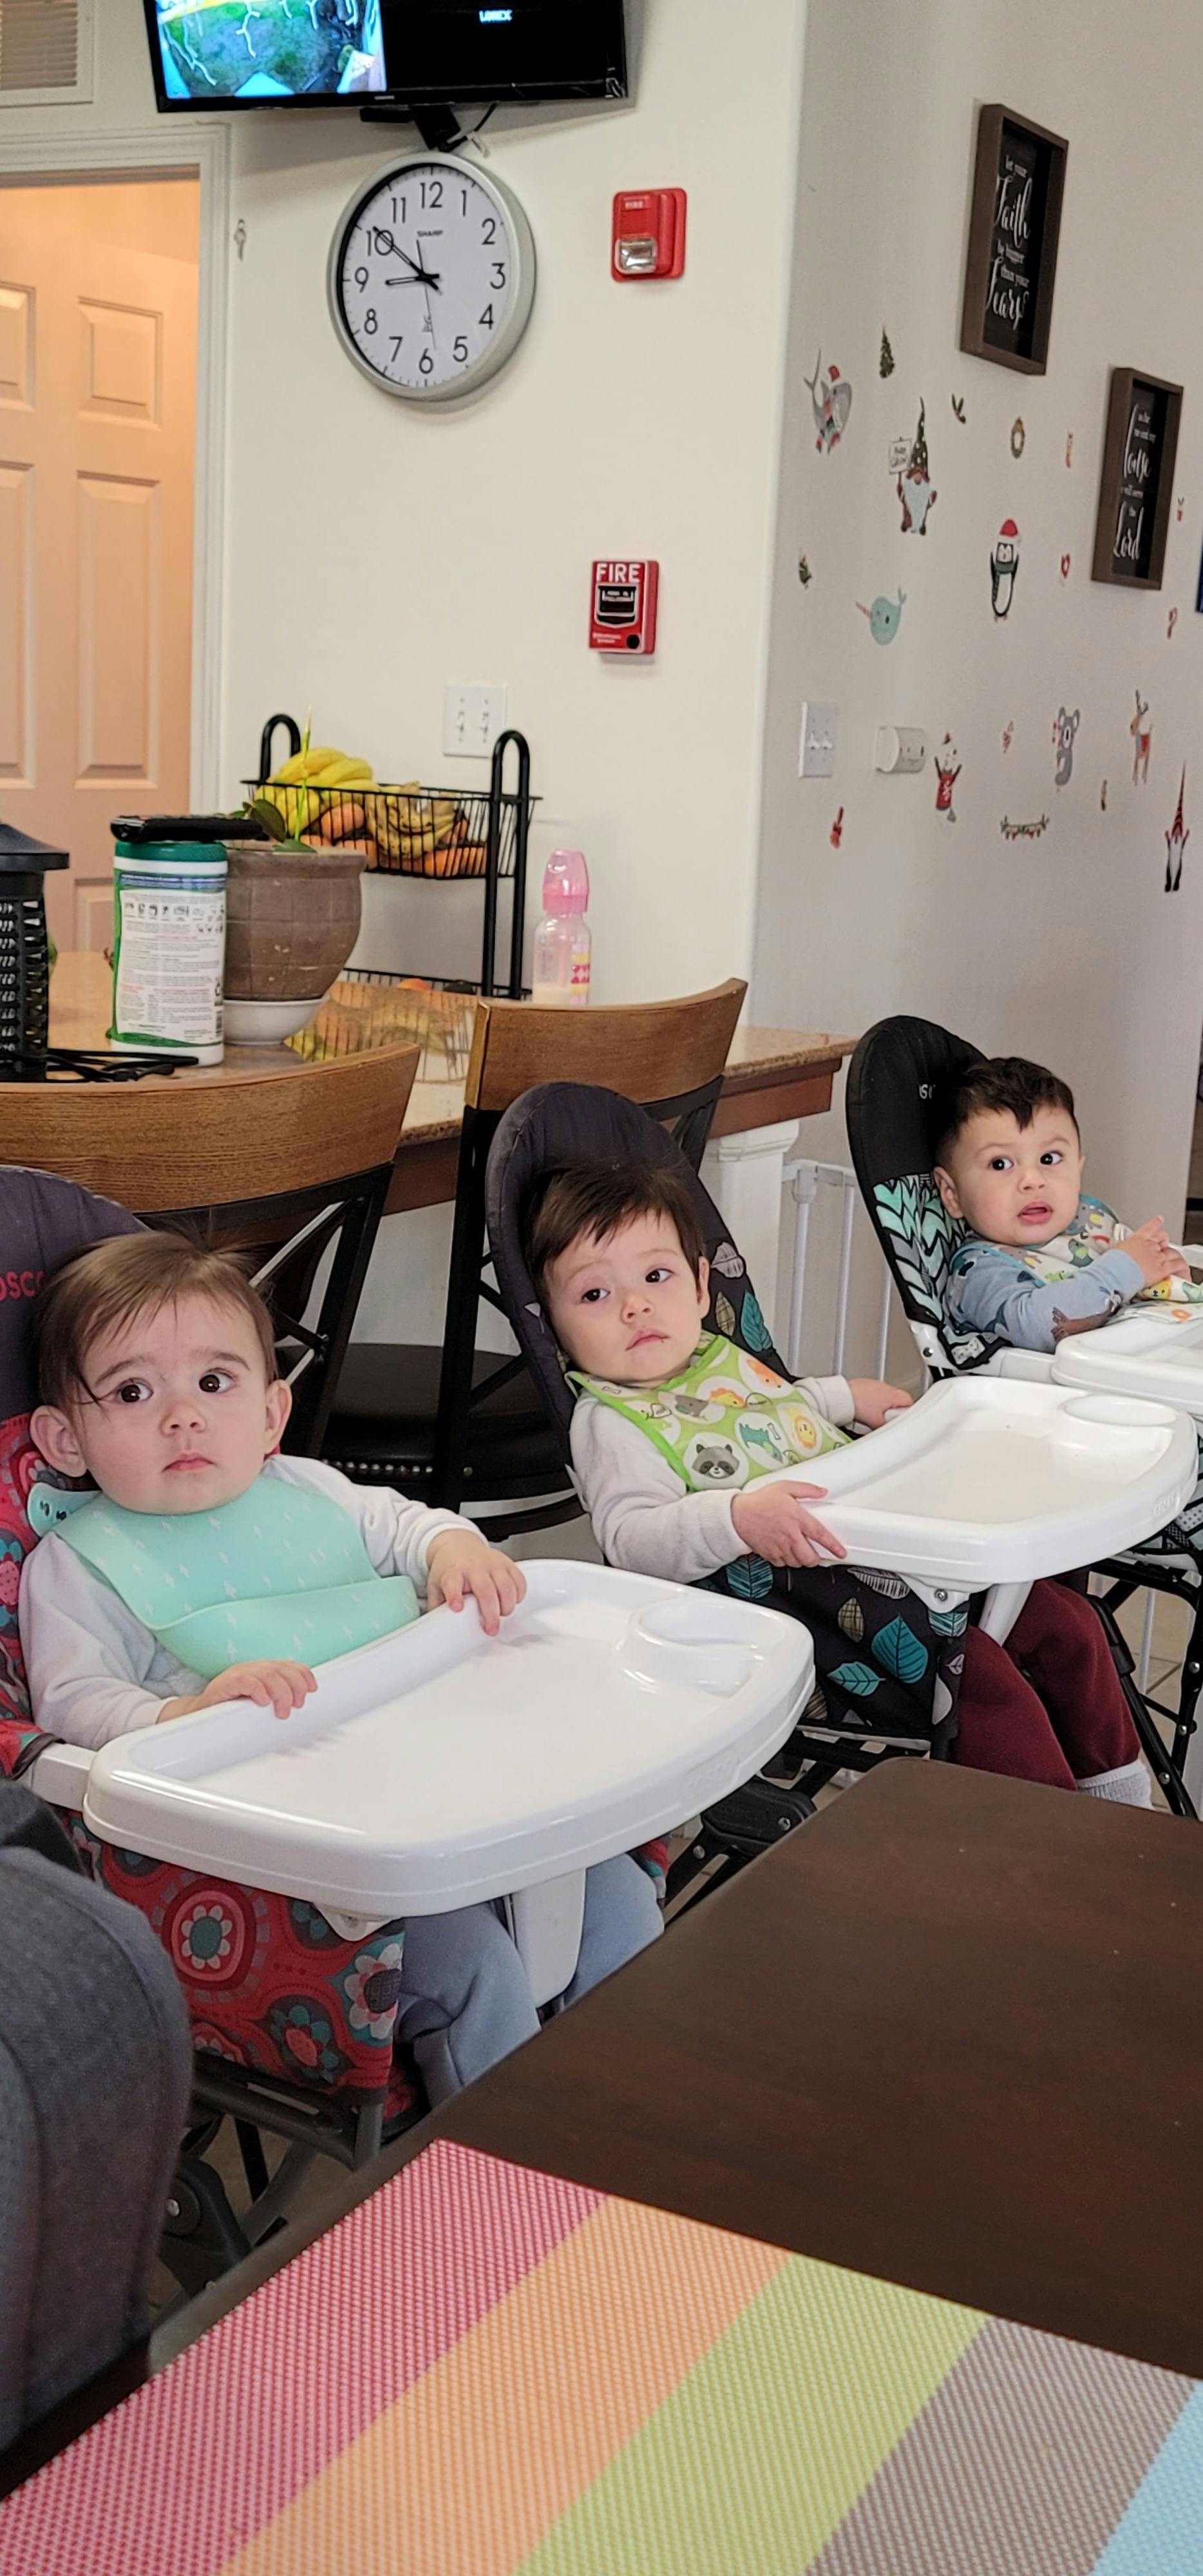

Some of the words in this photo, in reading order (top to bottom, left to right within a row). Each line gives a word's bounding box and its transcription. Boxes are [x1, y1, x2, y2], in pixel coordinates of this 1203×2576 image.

[420, 181, 443, 209] 12
[460, 189, 467, 216] 1
[391, 196, 406, 224] 11
[993, 175, 1033, 249] Faith
[366, 229, 394, 256] 10
[481, 218, 496, 245] 2
[354, 267, 369, 293] 9
[489, 262, 506, 290] 3
[363, 308, 378, 335] 8
[478, 303, 495, 330] 4
[388, 336, 403, 363] 7
[419, 347, 433, 374] 6
[452, 336, 468, 363] 5
[1113, 501, 1144, 560] Lord
[596, 562, 642, 583] FIRE
